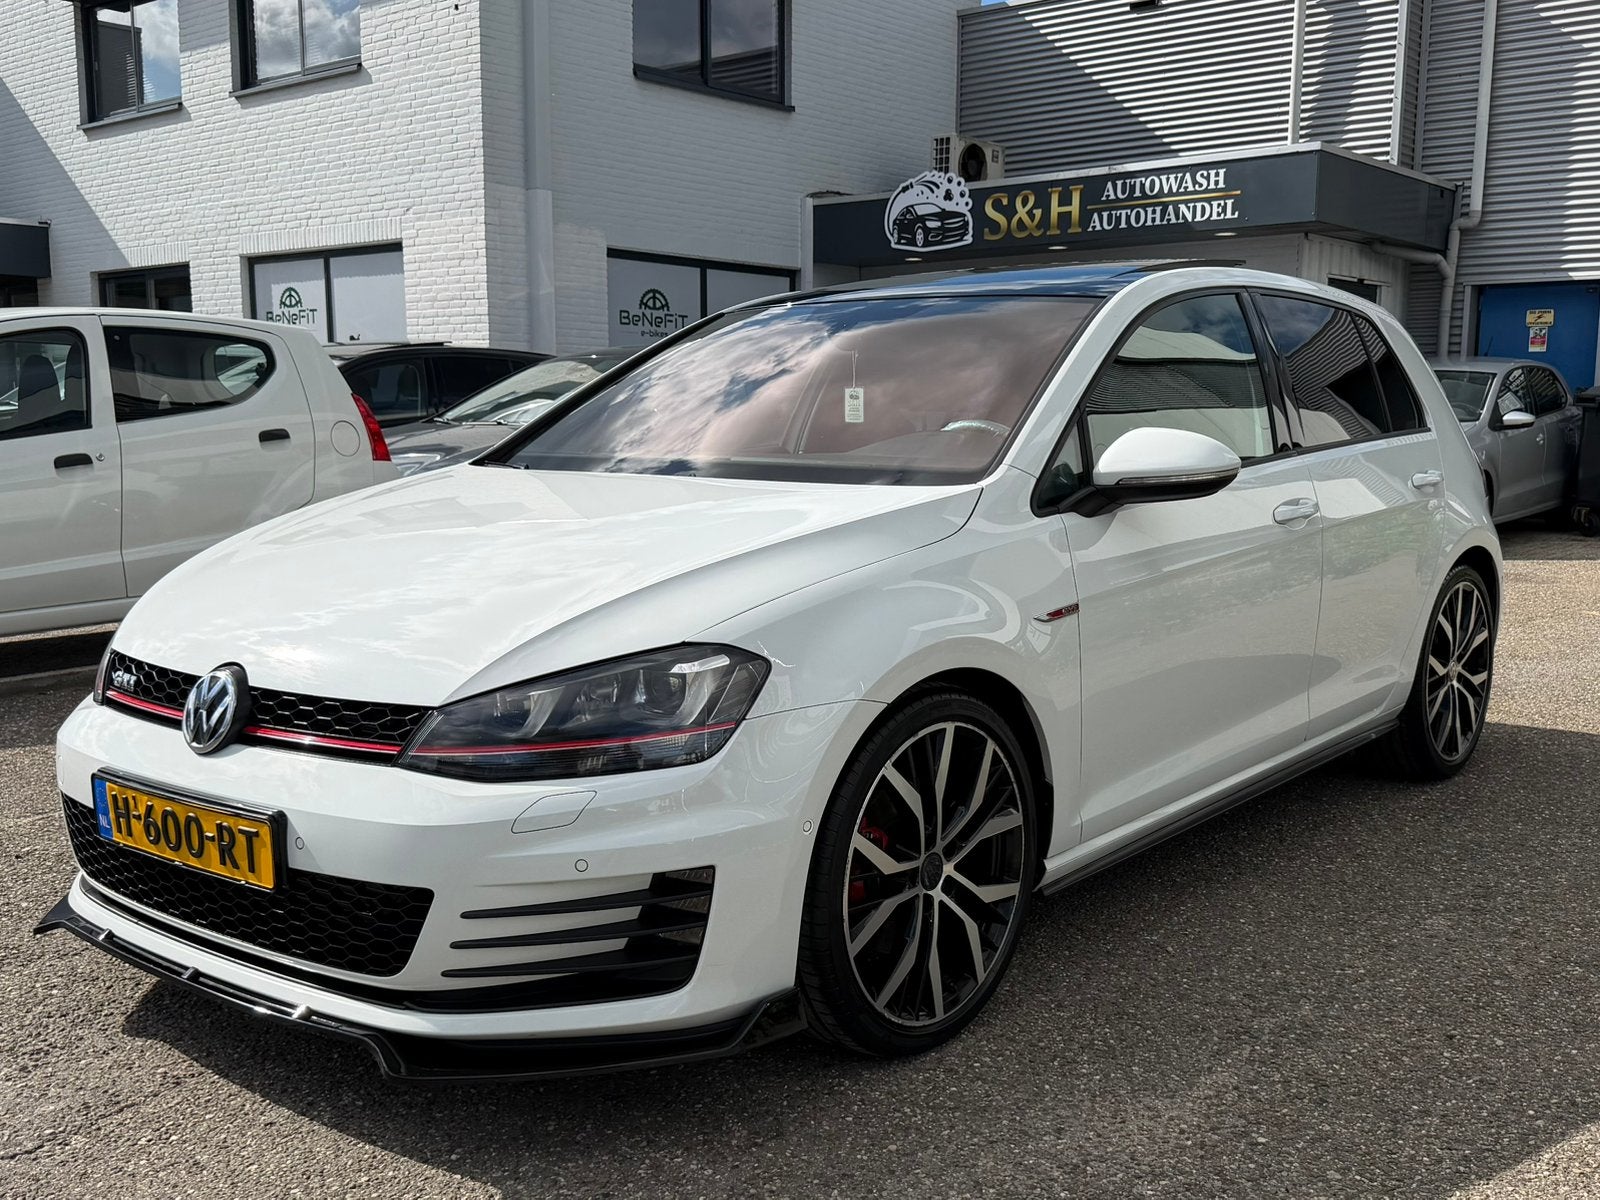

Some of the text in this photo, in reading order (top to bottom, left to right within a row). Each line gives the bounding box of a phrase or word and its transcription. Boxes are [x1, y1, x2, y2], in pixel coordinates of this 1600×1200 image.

[1101, 168, 1227, 201] AUTOWASH
[983, 185, 1085, 241] S&H
[1087, 198, 1239, 232] AUTOHANDEL
[619, 309, 689, 330] BeNeFiT
[99, 813, 111, 829] NL
[110, 791, 261, 874] H-600-RT
